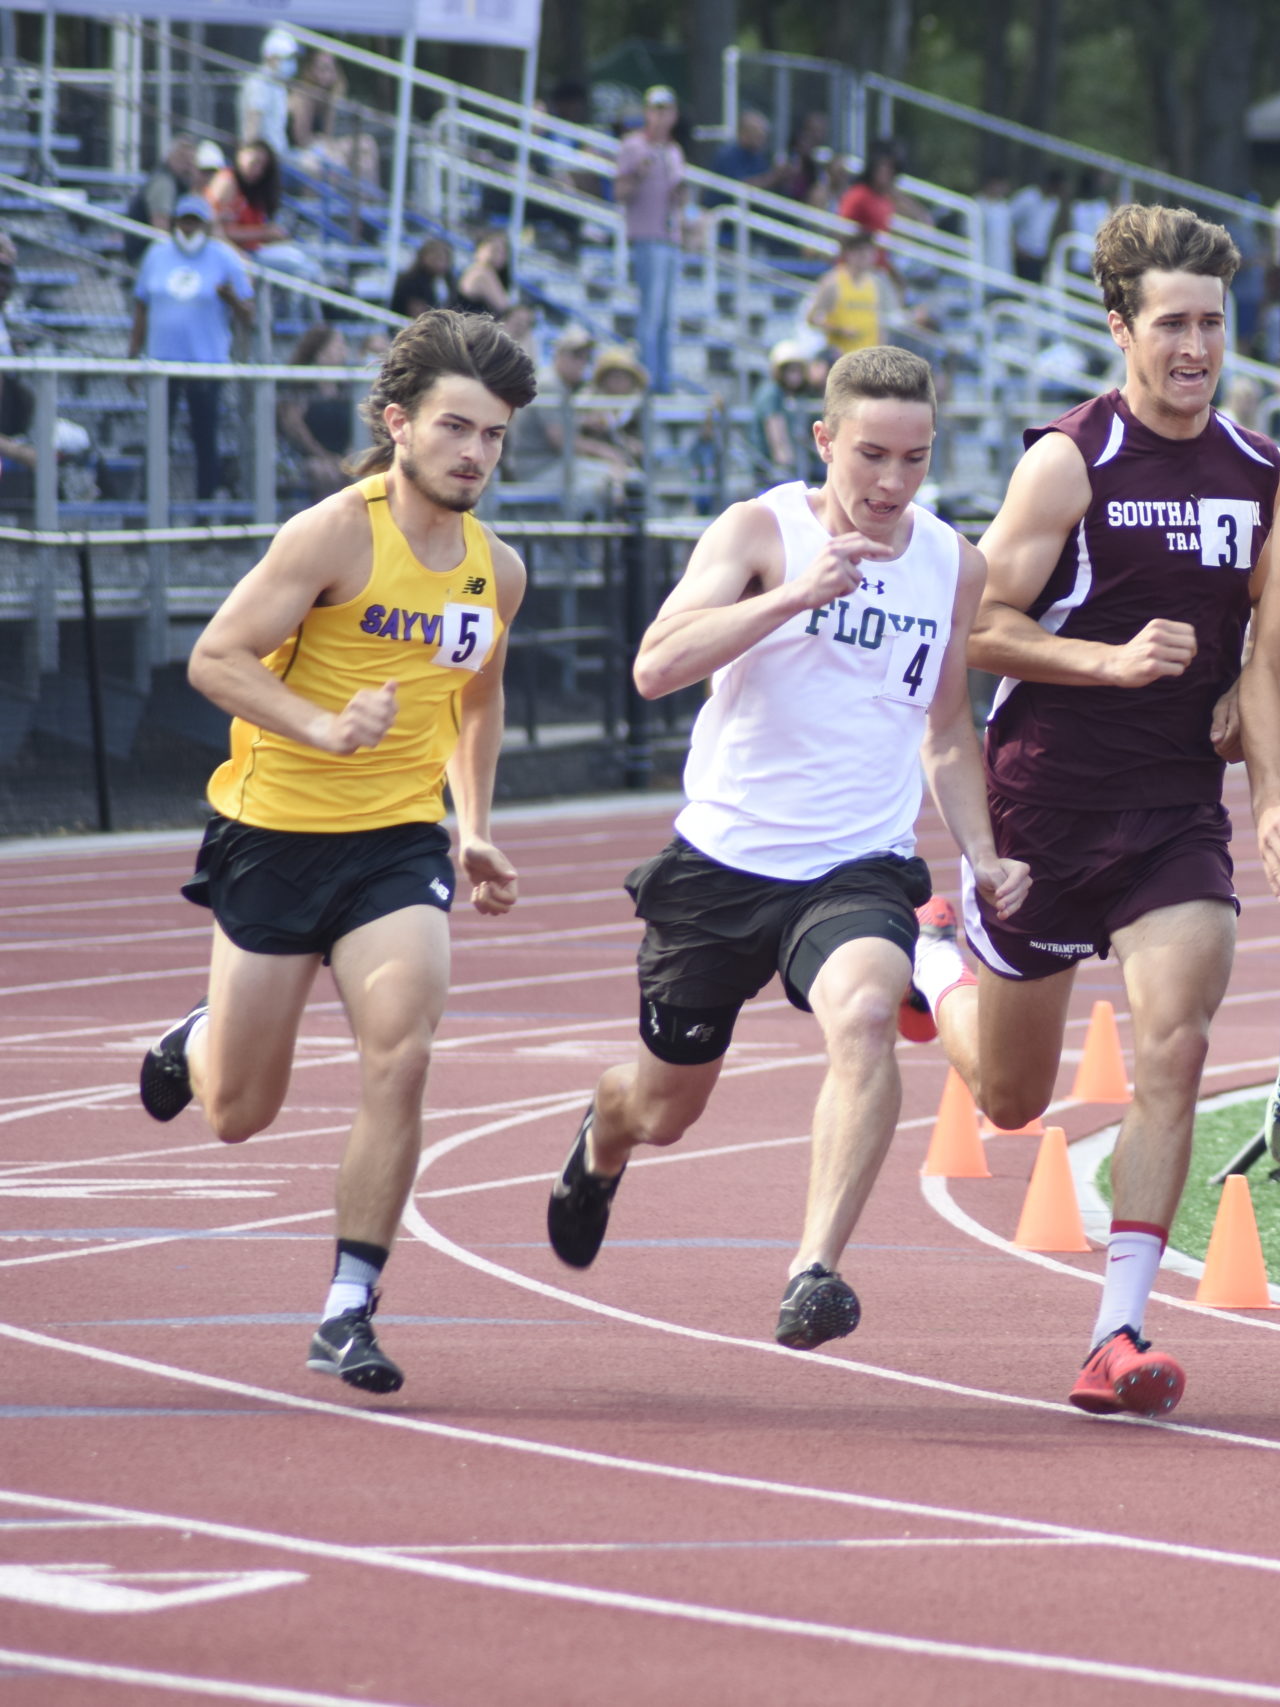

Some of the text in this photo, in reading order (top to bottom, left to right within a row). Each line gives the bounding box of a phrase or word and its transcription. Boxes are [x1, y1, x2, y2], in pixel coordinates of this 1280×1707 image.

[1107, 501, 1262, 526] SOUTHAN
[1166, 532, 1201, 551] TRA
[1217, 514, 1238, 568] 3
[451, 612, 480, 663] 5
[902, 642, 931, 697] 4
[1029, 940, 1095, 954] SOUTHAMPTON
